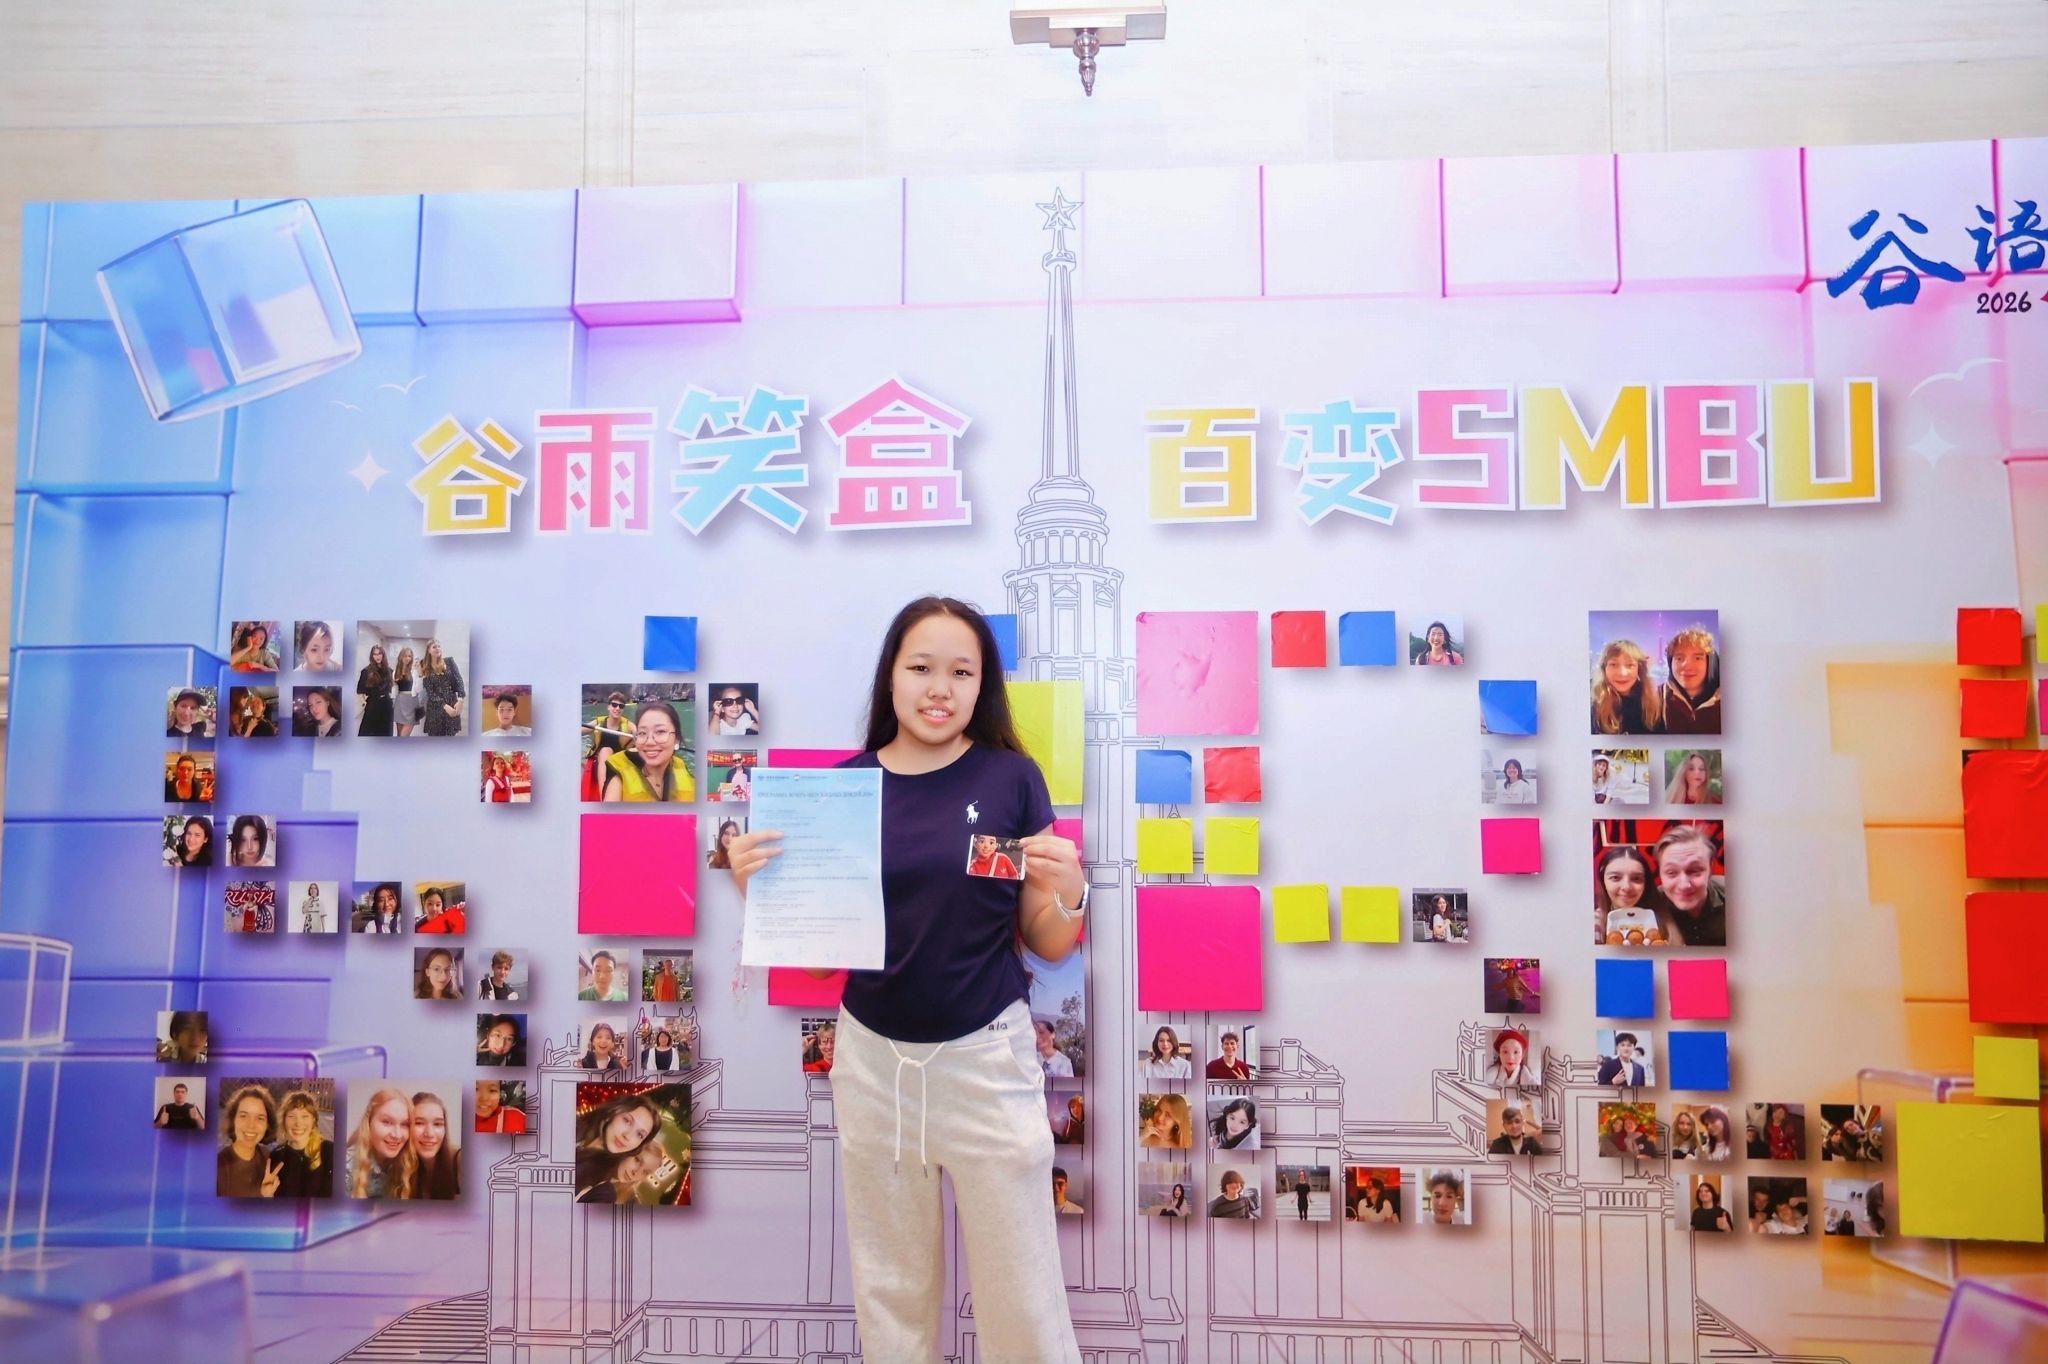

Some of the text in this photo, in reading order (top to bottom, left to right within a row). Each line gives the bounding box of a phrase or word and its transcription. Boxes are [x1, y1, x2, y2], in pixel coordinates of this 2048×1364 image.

[1976, 291, 2032, 314] 2026
[406, 373, 973, 536] 谷雨笑盒
[225, 890, 275, 906] RUSIA
